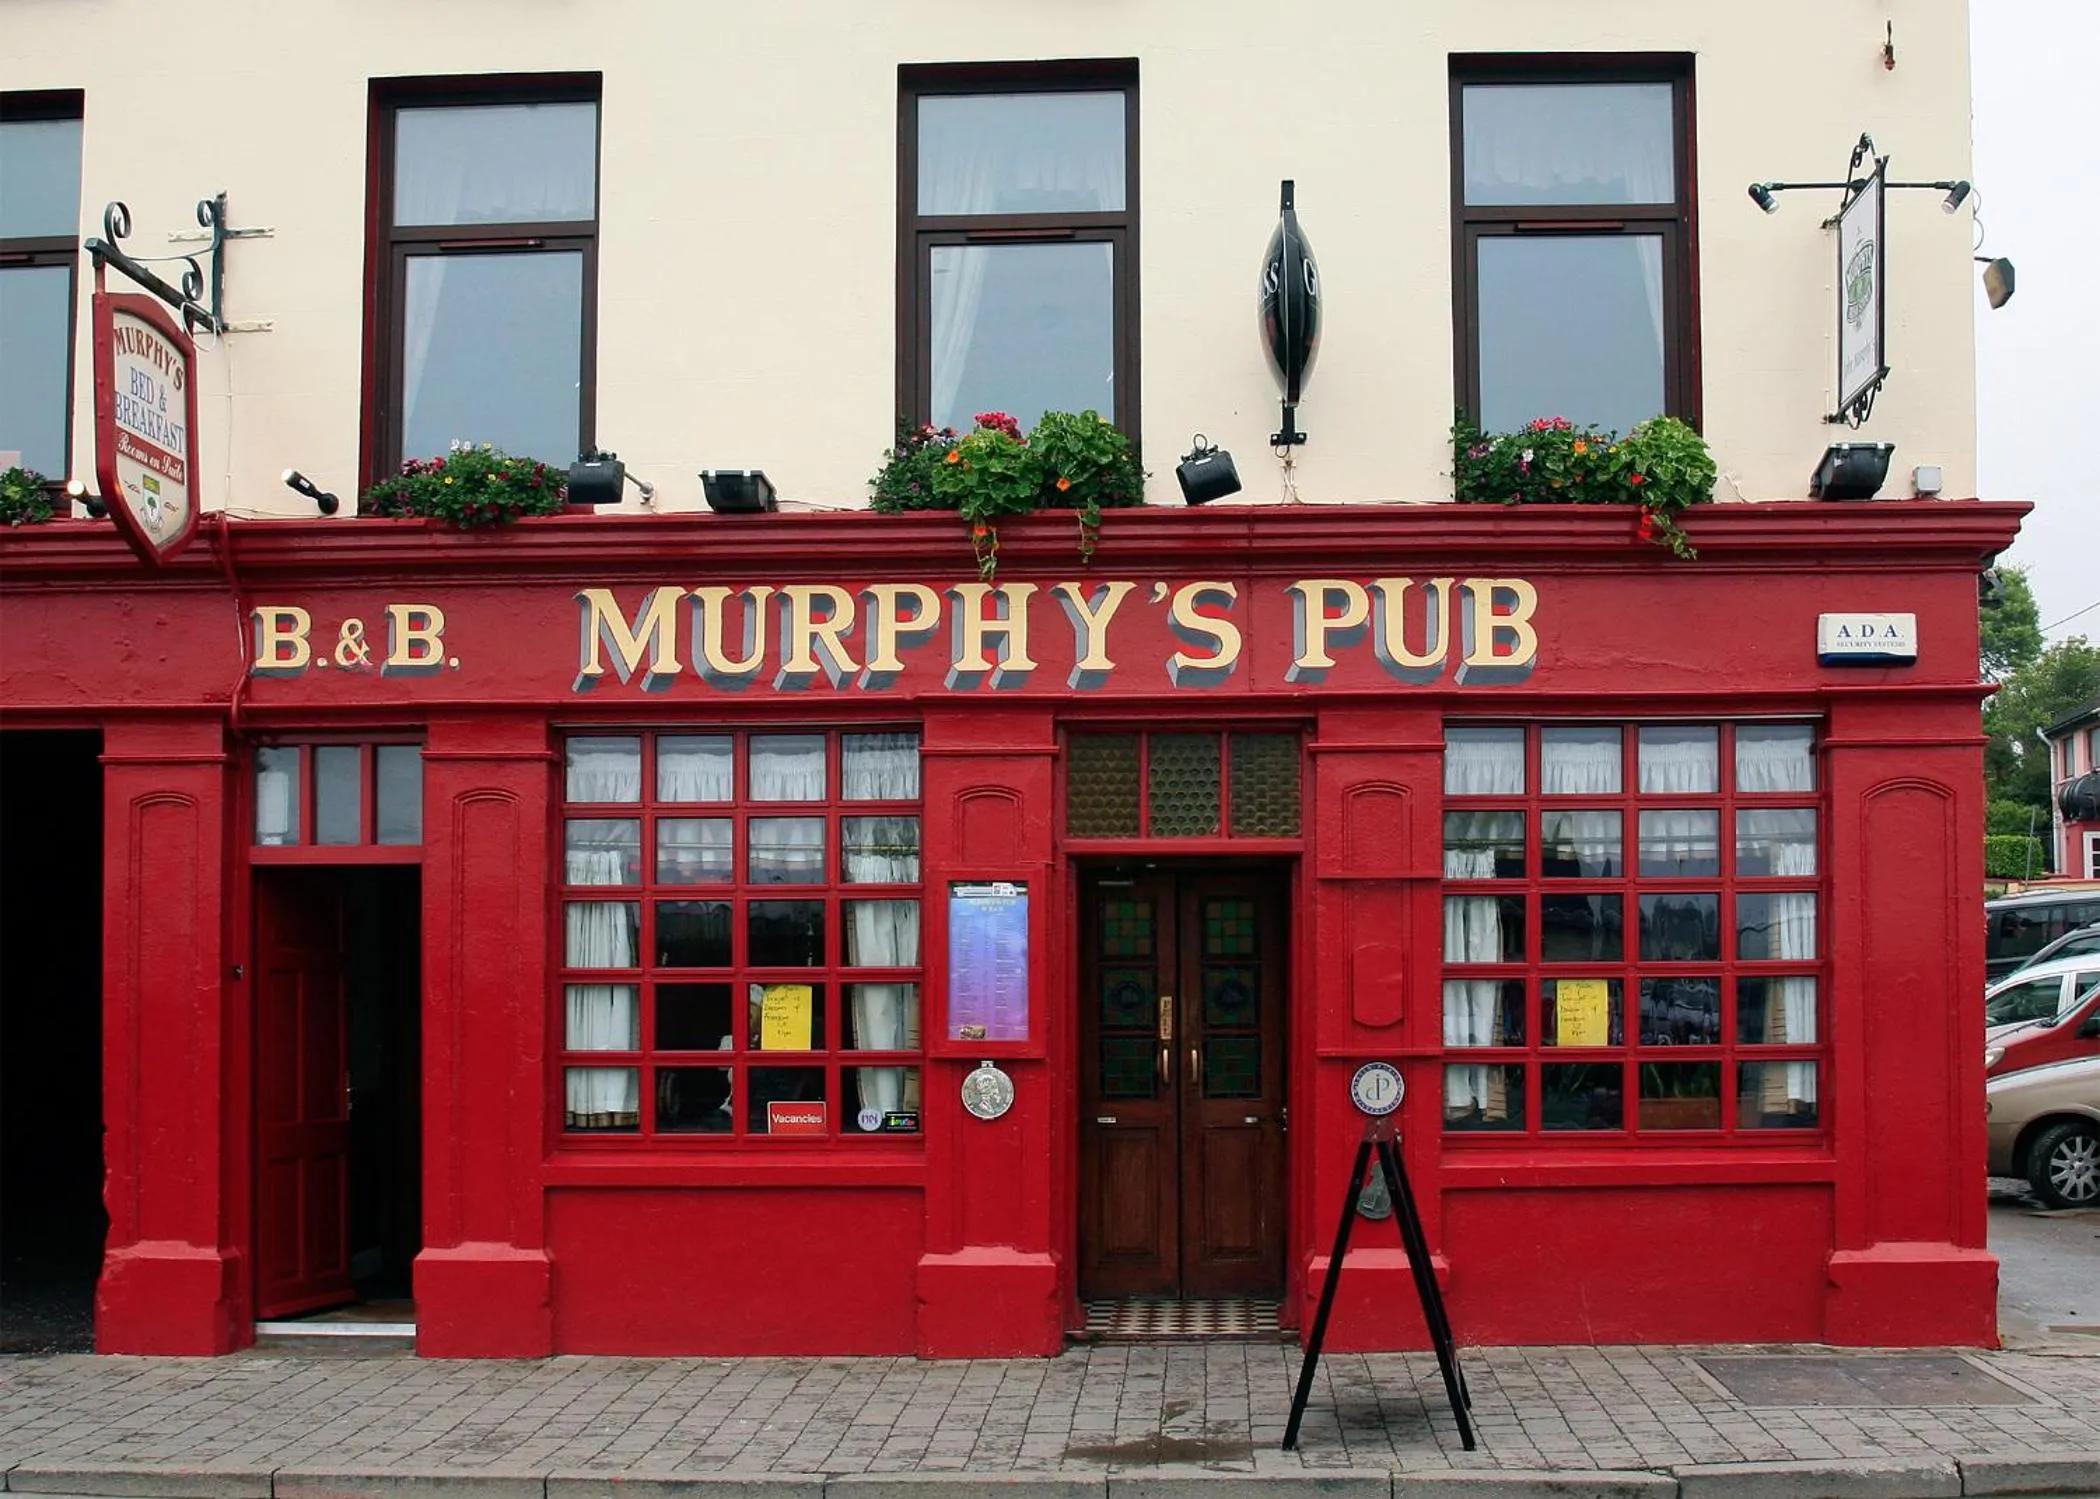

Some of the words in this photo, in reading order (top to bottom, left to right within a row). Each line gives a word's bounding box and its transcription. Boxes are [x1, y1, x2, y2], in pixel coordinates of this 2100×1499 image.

[114, 326, 184, 391] MURPHY'S
[130, 366, 154, 405] BED
[159, 384, 167, 412] &
[115, 391, 184, 453] BREAKFAST
[574, 581, 1243, 690] MURPHY'S
[1284, 577, 1538, 685] PUB
[771, 1113, 823, 1124] Vacancies
